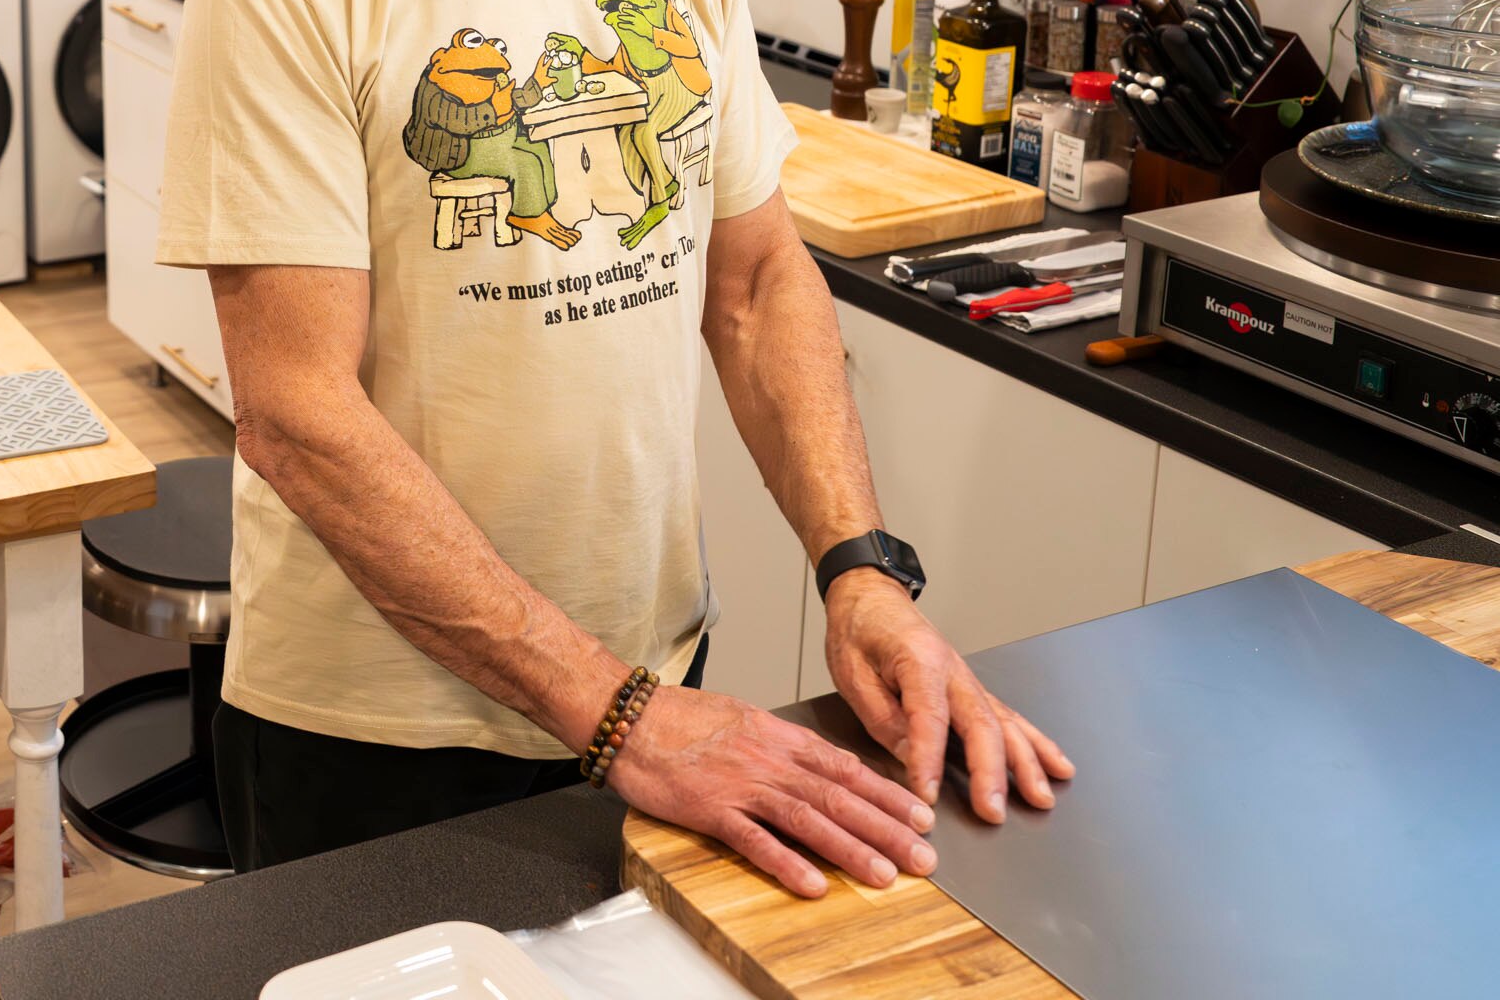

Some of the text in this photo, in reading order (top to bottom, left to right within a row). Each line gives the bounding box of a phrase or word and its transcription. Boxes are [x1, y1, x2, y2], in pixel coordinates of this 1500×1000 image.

[458, 282, 502, 302] “We
[507, 277, 552, 300] must
[557, 273, 592, 295] stop
[596, 252, 655, 286] eating!”
[544, 280, 679, 325] as he ate another.
[1205, 295, 1275, 335] Krampouz
[1285, 311, 1333, 335] CAUTION HOT
